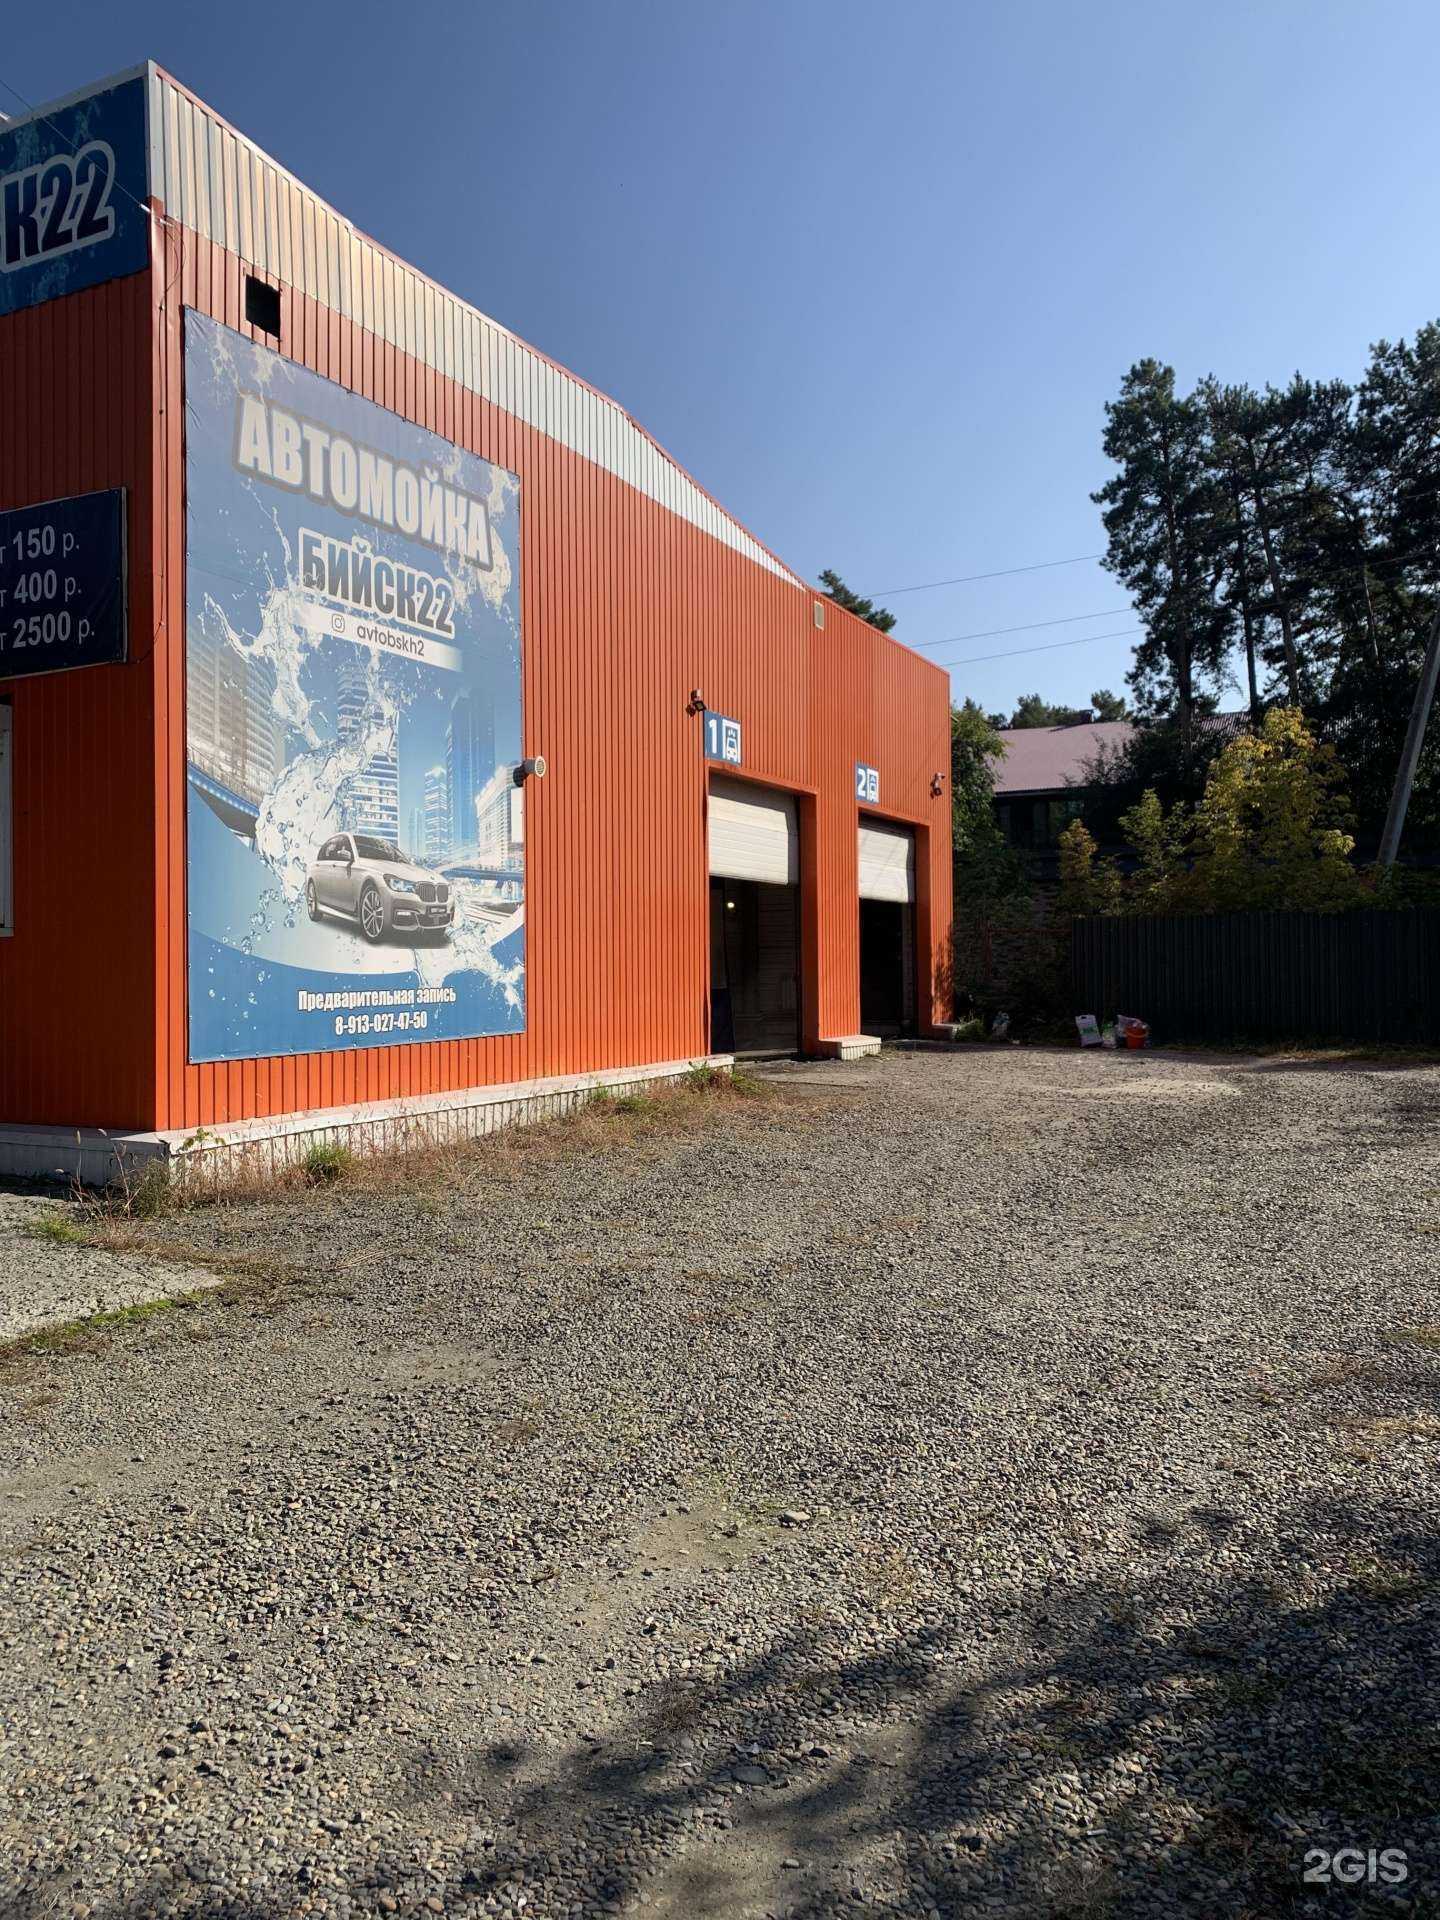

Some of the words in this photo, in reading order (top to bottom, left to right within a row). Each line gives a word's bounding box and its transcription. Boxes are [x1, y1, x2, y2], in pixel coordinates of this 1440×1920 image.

[0, 141, 115, 272] К22
[236, 394, 491, 570] АВТОМОЙКА
[13, 525, 56, 561] 150
[62, 532, 80, 558] р.
[14, 569, 57, 604] 400
[64, 577, 82, 602] р.
[301, 529, 454, 638] БИЙСК22
[13, 611, 71, 649] 2500
[78, 619, 95, 645] р.
[356, 622, 426, 658] avtobskh2
[708, 718, 718, 754] 1
[857, 768, 867, 797] 2
[298, 990, 415, 1011] Предварительная
[416, 988, 457, 1003] запись
[335, 1011, 428, 1035] 8-913-027-47-50
